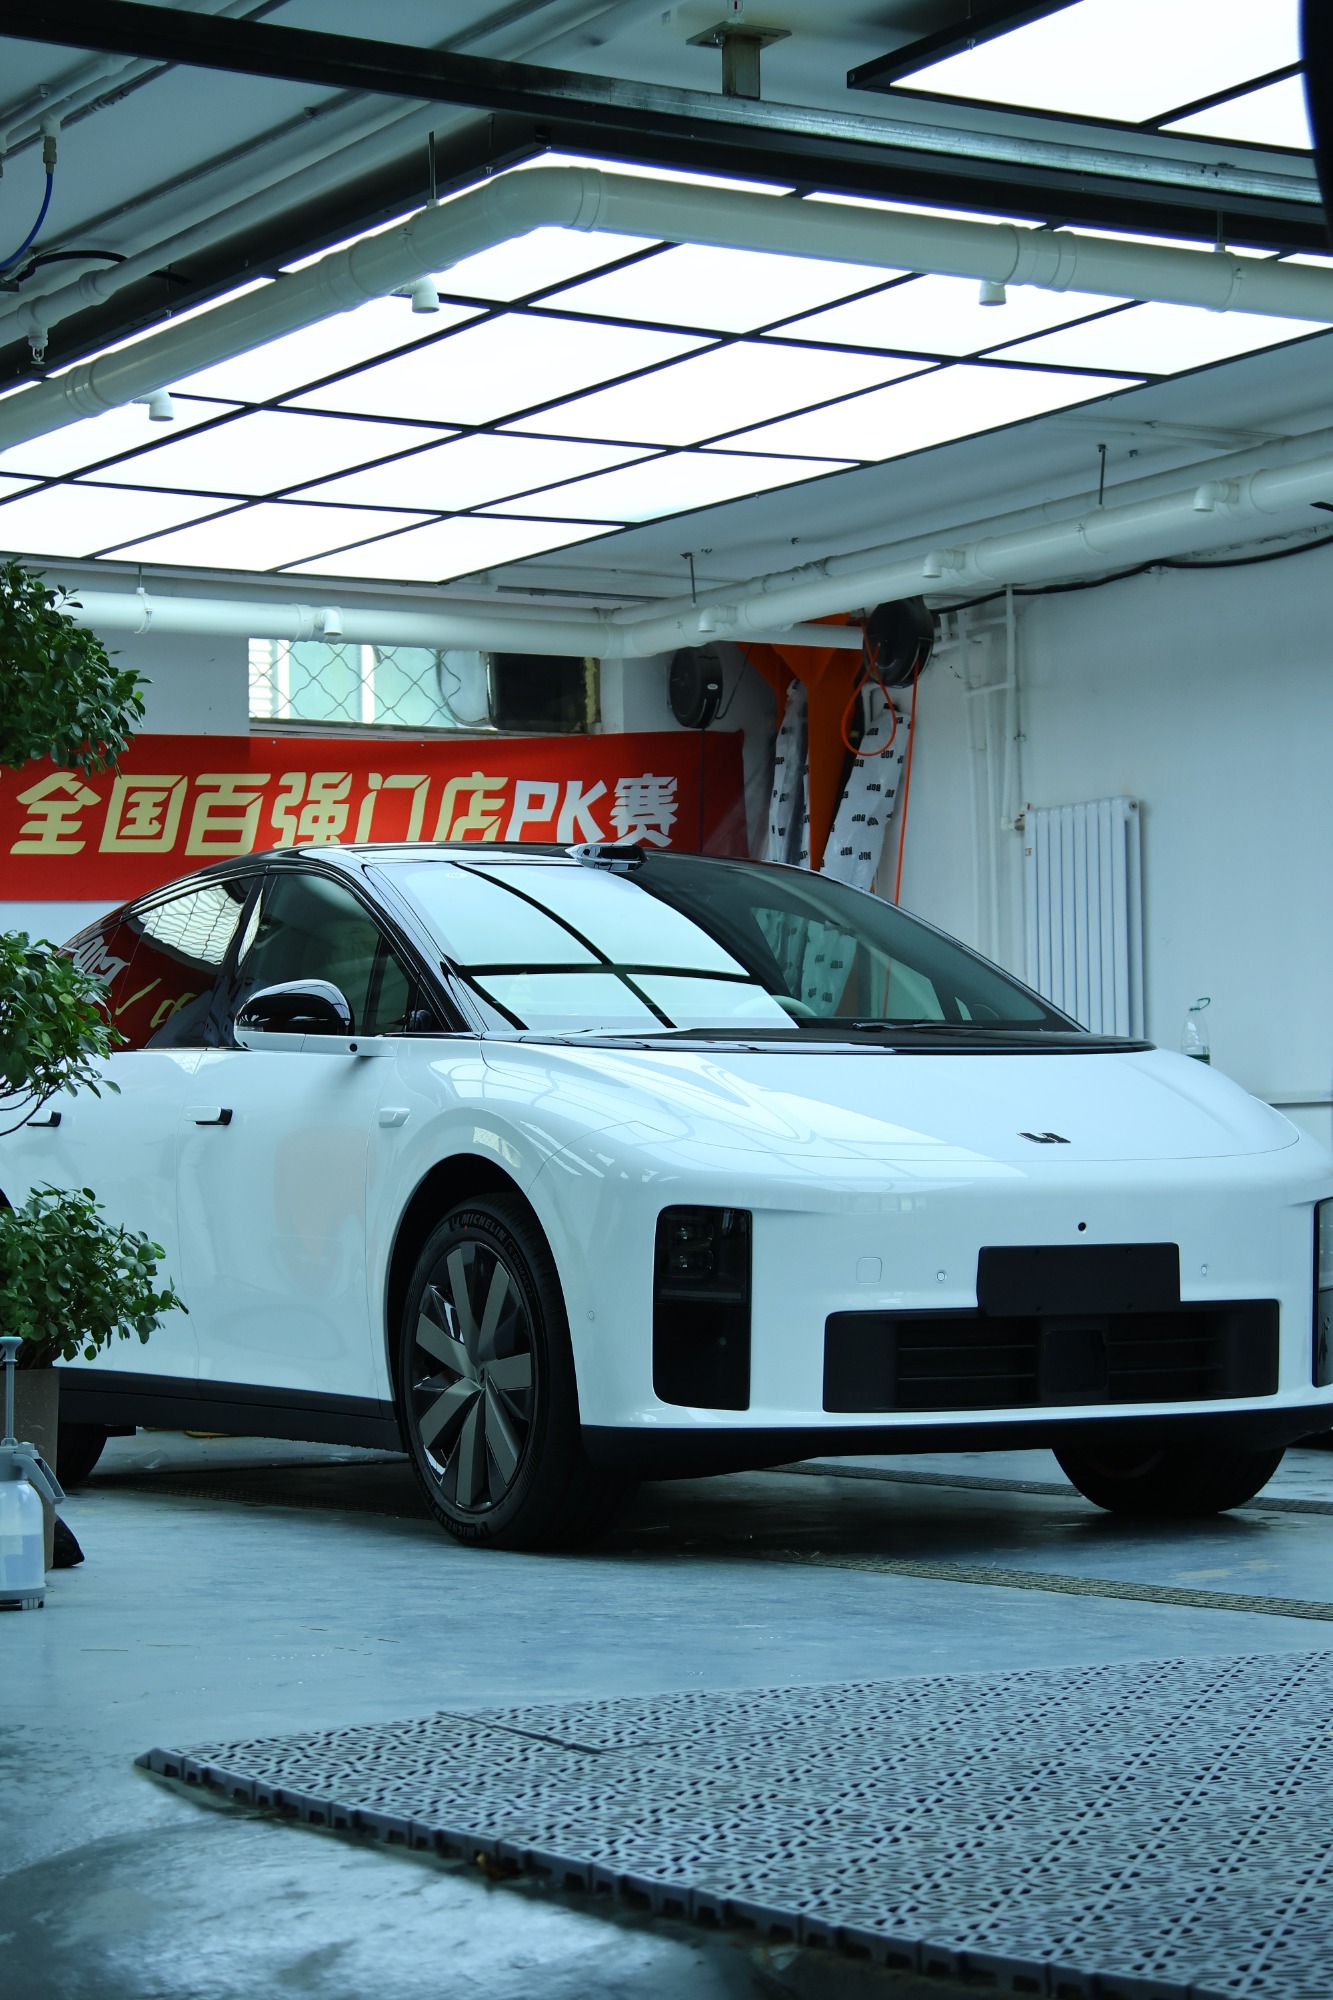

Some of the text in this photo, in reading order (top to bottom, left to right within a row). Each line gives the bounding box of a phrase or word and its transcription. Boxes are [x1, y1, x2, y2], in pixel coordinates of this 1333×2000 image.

[9, 771, 679, 855] 全国百强门店PK赛
[461, 1213, 507, 1242] MICHELIN
[432, 1506, 475, 1537] MICHELIN
